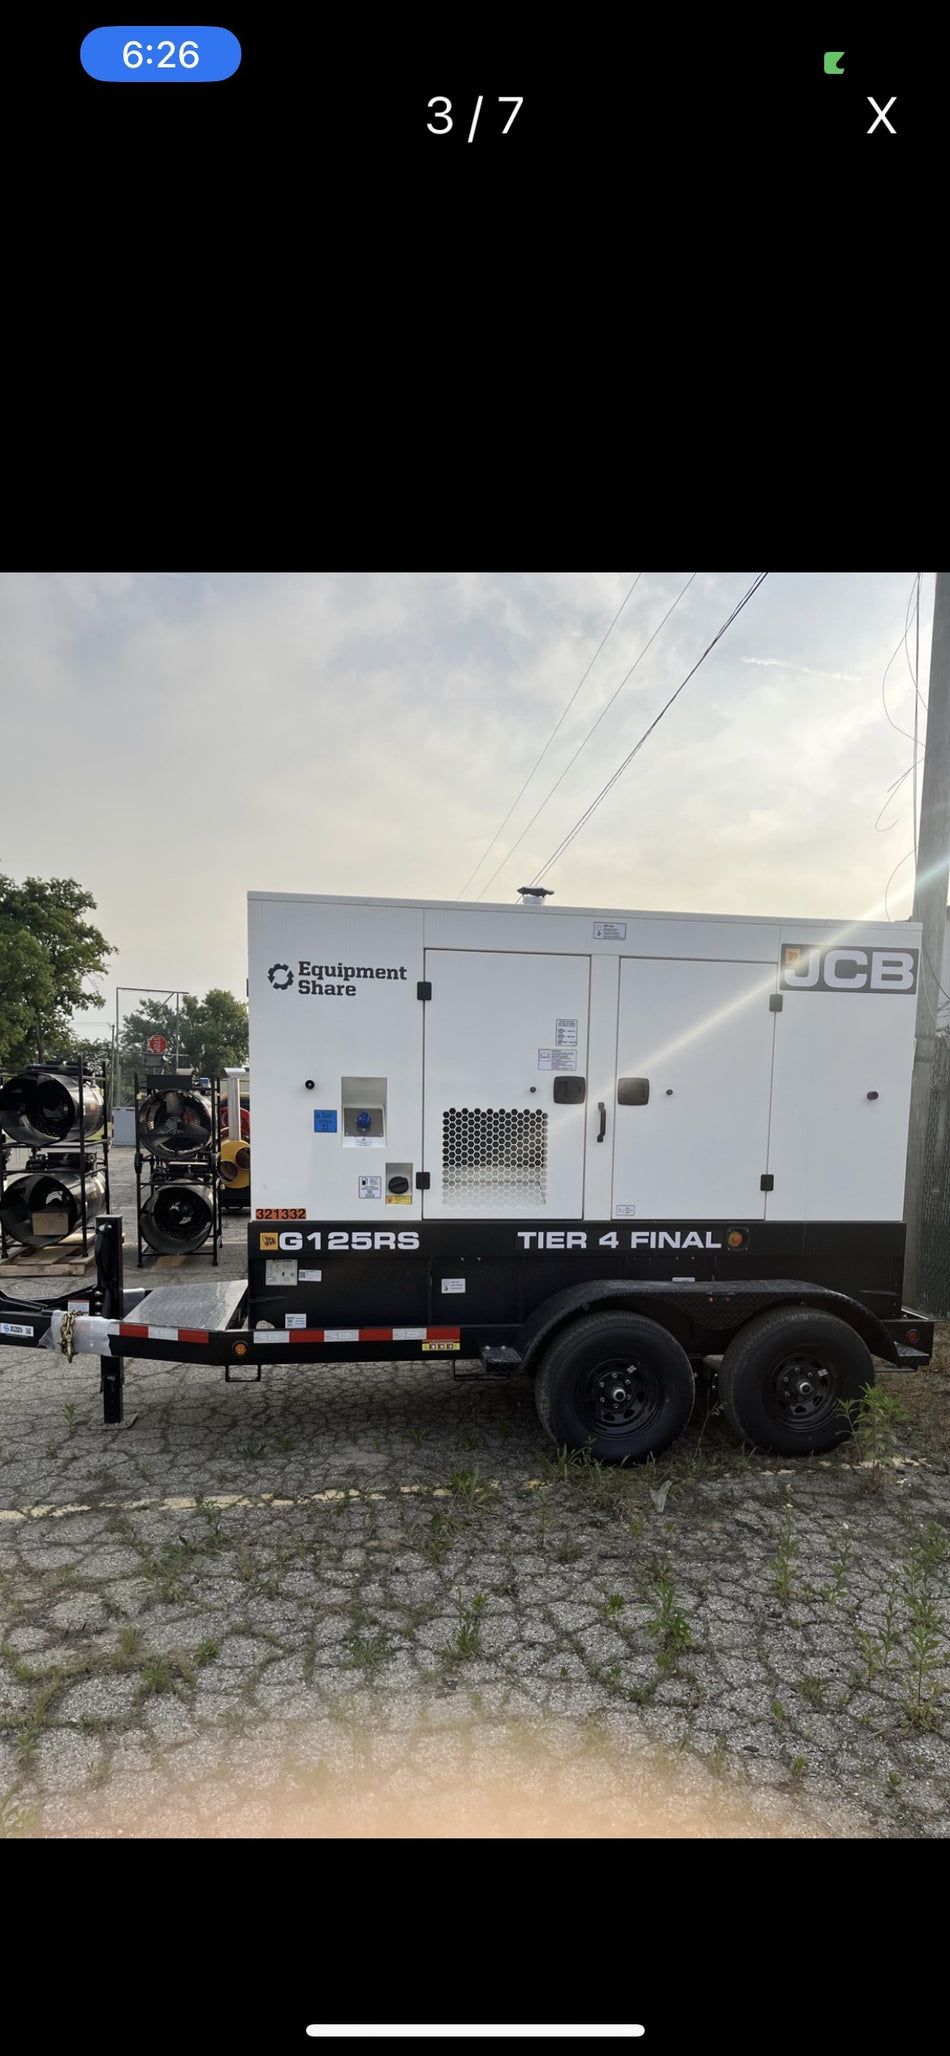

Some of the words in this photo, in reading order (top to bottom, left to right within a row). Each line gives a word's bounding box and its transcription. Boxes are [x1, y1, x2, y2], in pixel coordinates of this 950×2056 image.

[298, 961, 407, 981] Equipment
[784, 949, 914, 990] JCB
[298, 980, 357, 997] Share
[256, 1209, 306, 1220] 321332
[279, 1231, 420, 1251] G125RS
[517, 1231, 587, 1250] TIER
[598, 1231, 619, 1250] 4
[630, 1231, 722, 1250] FINAL
